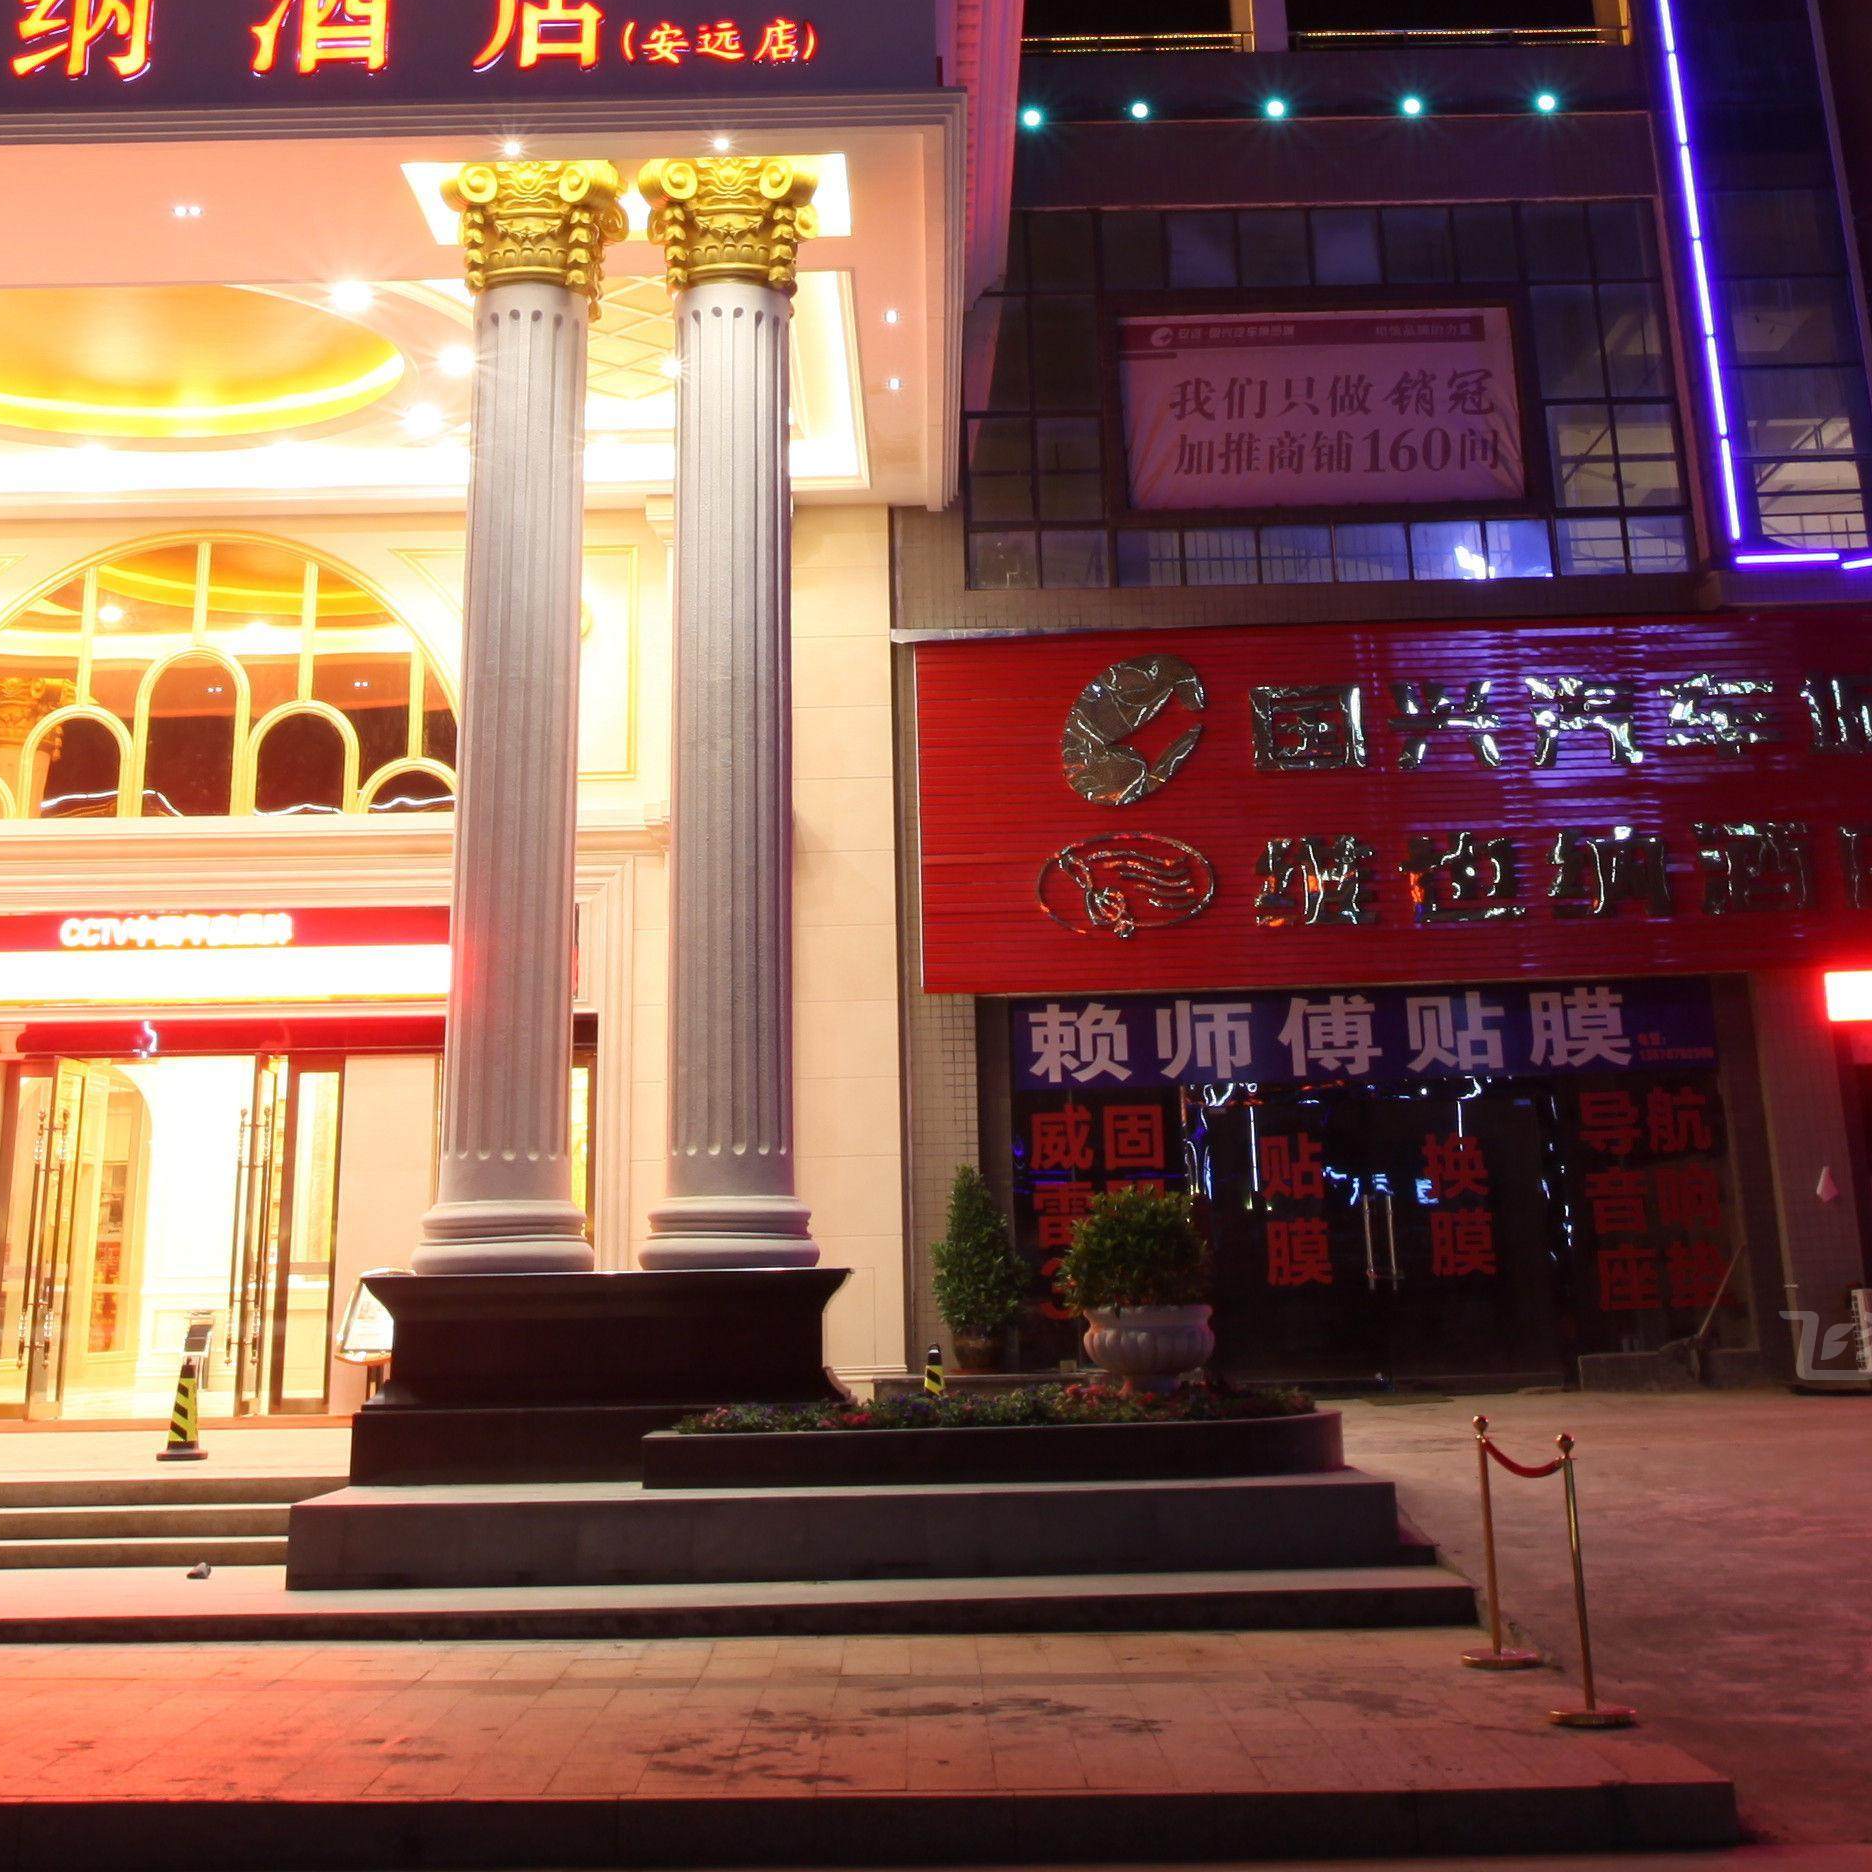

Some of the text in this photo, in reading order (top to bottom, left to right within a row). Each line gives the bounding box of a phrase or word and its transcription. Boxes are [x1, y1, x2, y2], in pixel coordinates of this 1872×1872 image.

[620, 16, 818, 66] (安远店)
[1173, 427, 1500, 475] 加推商铺160间
[1029, 982, 1633, 1084] 赖师傅贴膜
[1030, 1103, 1166, 1172] 威固
[1577, 1085, 1714, 1156] 导航
[1259, 1131, 1335, 1288] 贴膜
